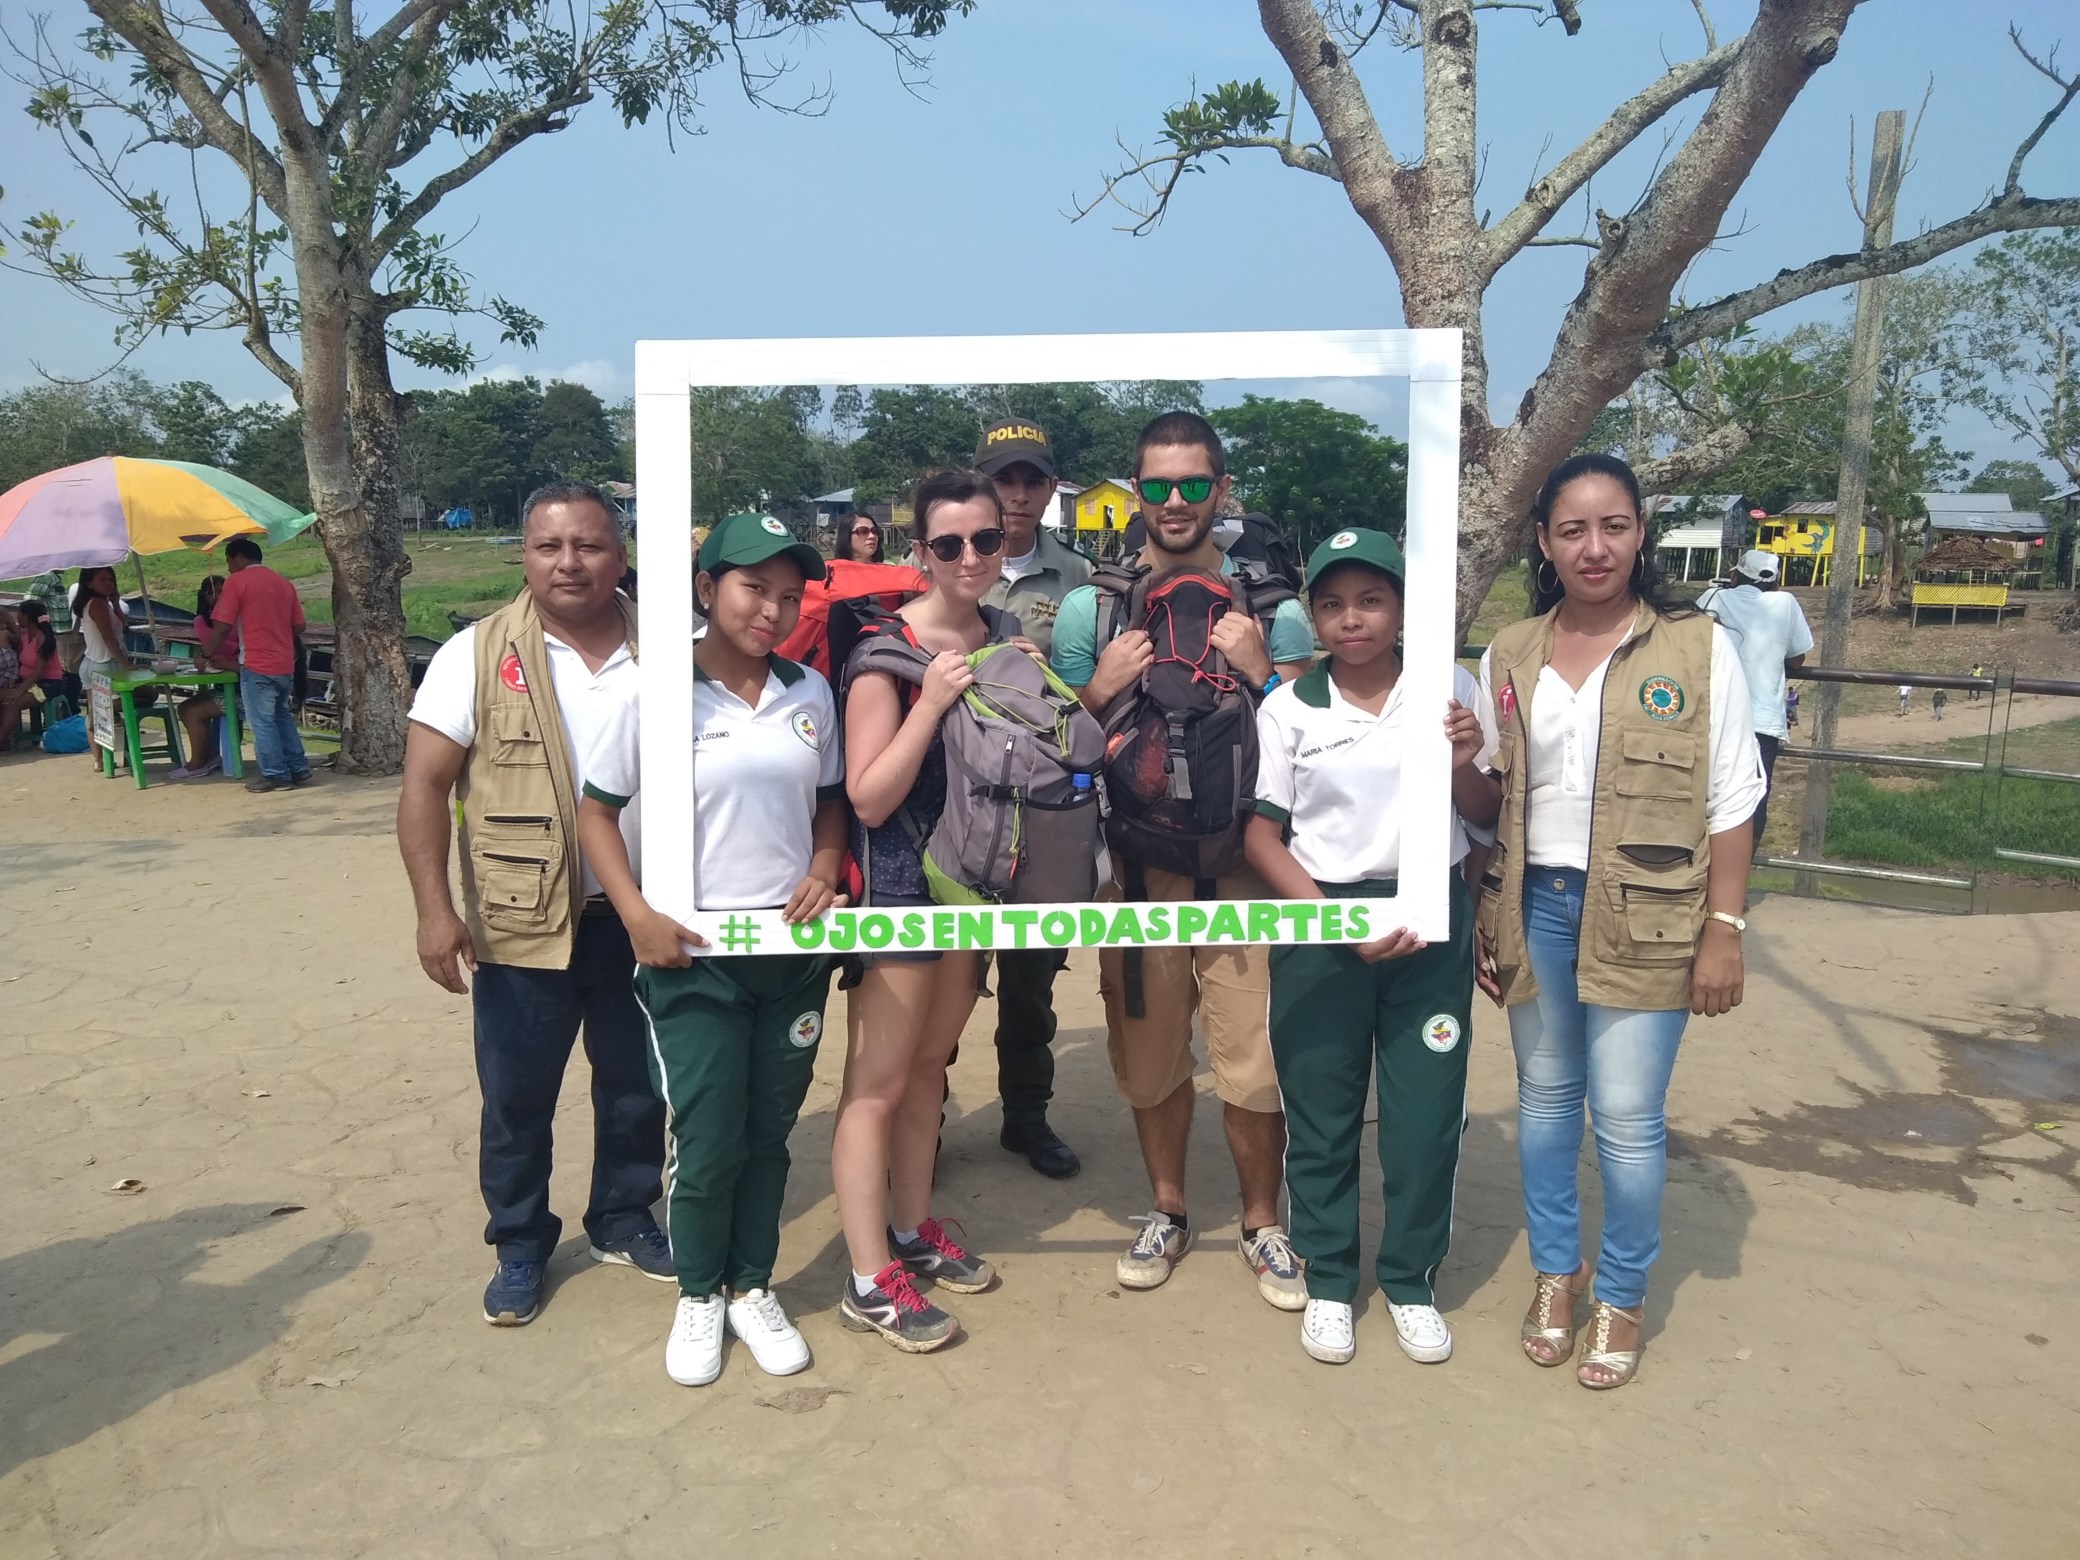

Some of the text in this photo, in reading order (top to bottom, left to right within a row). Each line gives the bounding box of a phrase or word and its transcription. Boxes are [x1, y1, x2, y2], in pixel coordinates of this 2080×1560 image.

[987, 425, 1047, 447] POLICIA
[702, 731, 730, 741] LOZANO
[1300, 737, 1354, 759] MARIA TORRES
